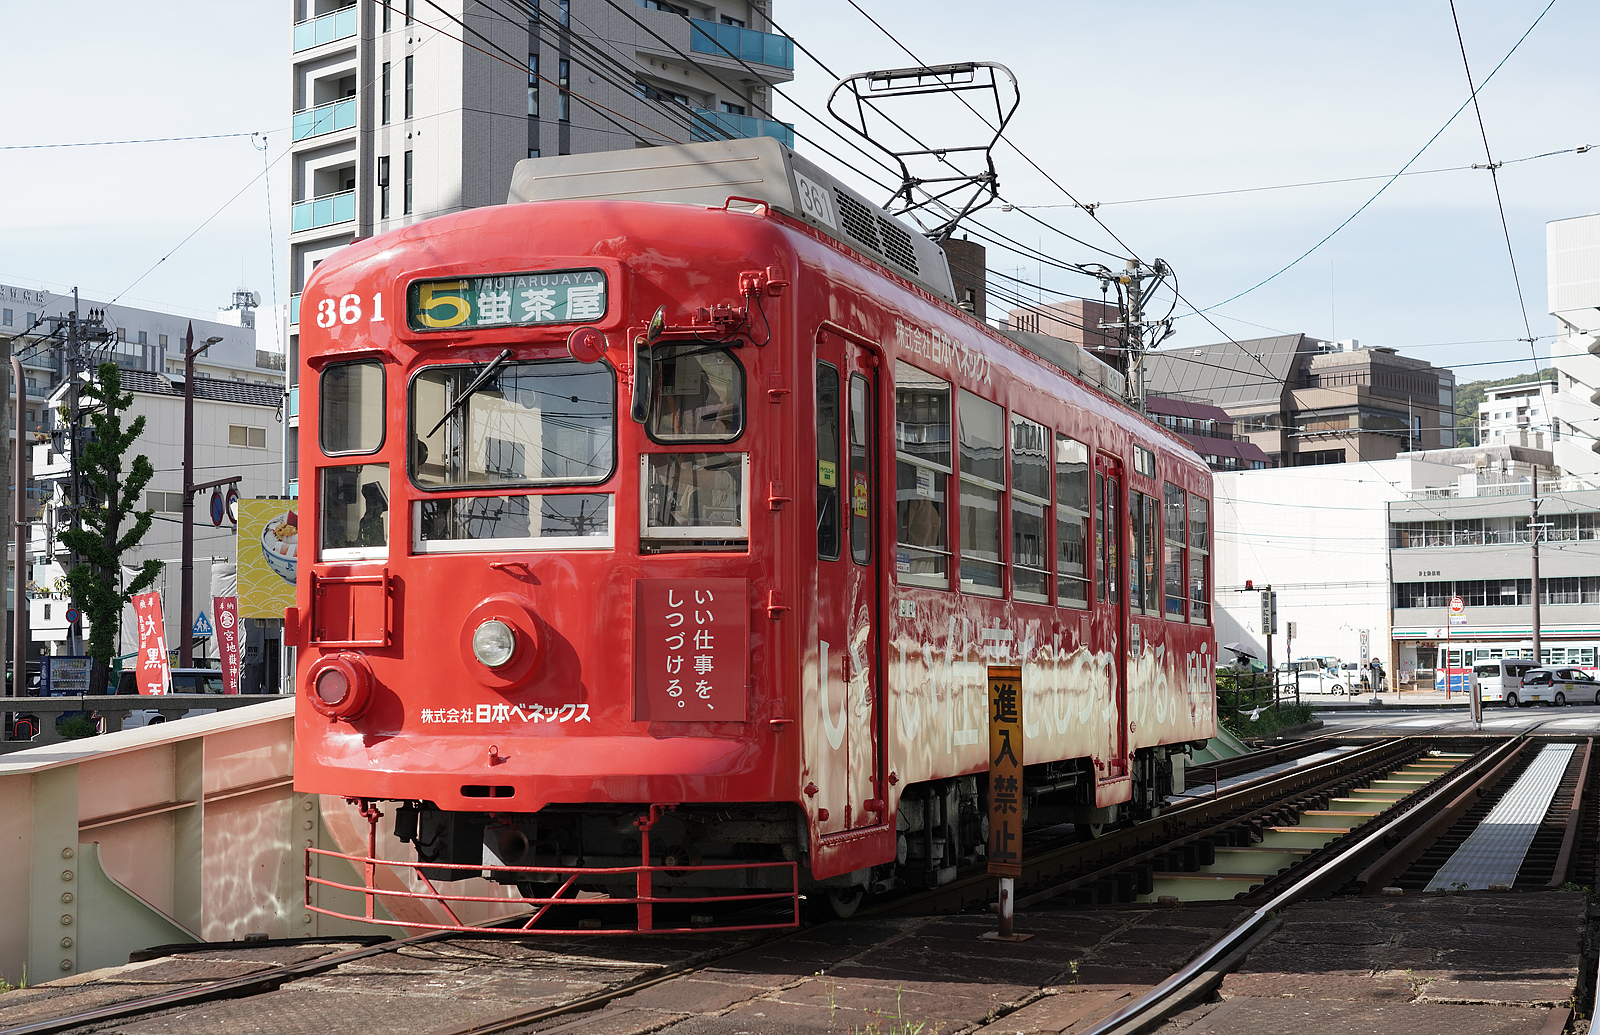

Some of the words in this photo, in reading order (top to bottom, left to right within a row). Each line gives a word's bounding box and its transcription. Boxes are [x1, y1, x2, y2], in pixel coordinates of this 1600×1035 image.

[800, 179, 831, 223] 361
[484, 273, 594, 290] HOTARUJAYA
[316, 292, 385, 328] 361
[416, 282, 471, 328] 5
[477, 286, 602, 325] 蛍茶屋
[896, 318, 992, 387] 株式会社日本ベネックス
[665, 589, 685, 708] しつづける。
[693, 590, 714, 710] いい仕事を、
[421, 703, 591, 723] 株式会社日本ベネックス
[993, 683, 1018, 860] 進入禁止
